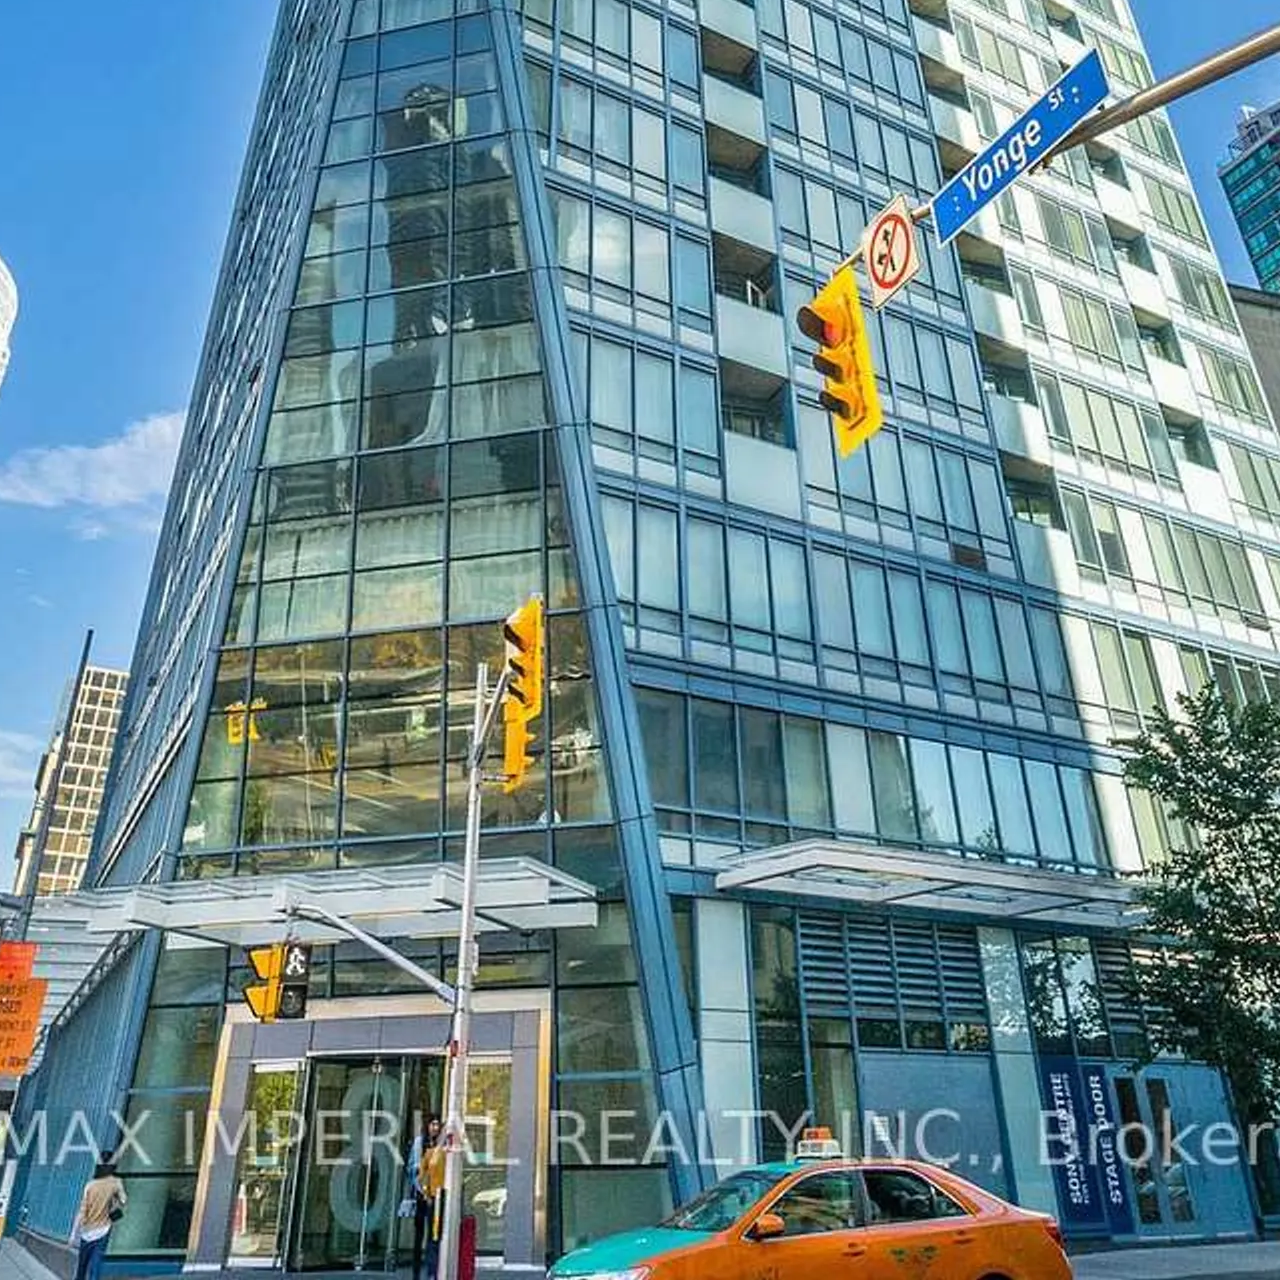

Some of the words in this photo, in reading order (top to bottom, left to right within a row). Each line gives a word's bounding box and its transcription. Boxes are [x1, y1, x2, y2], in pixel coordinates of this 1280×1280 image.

[962, 119, 1042, 202] Yonge
[1089, 1075, 1109, 1130] DOOR
[1066, 1151, 1083, 1204] SONY
[1100, 1135, 1123, 1204] STAGE
